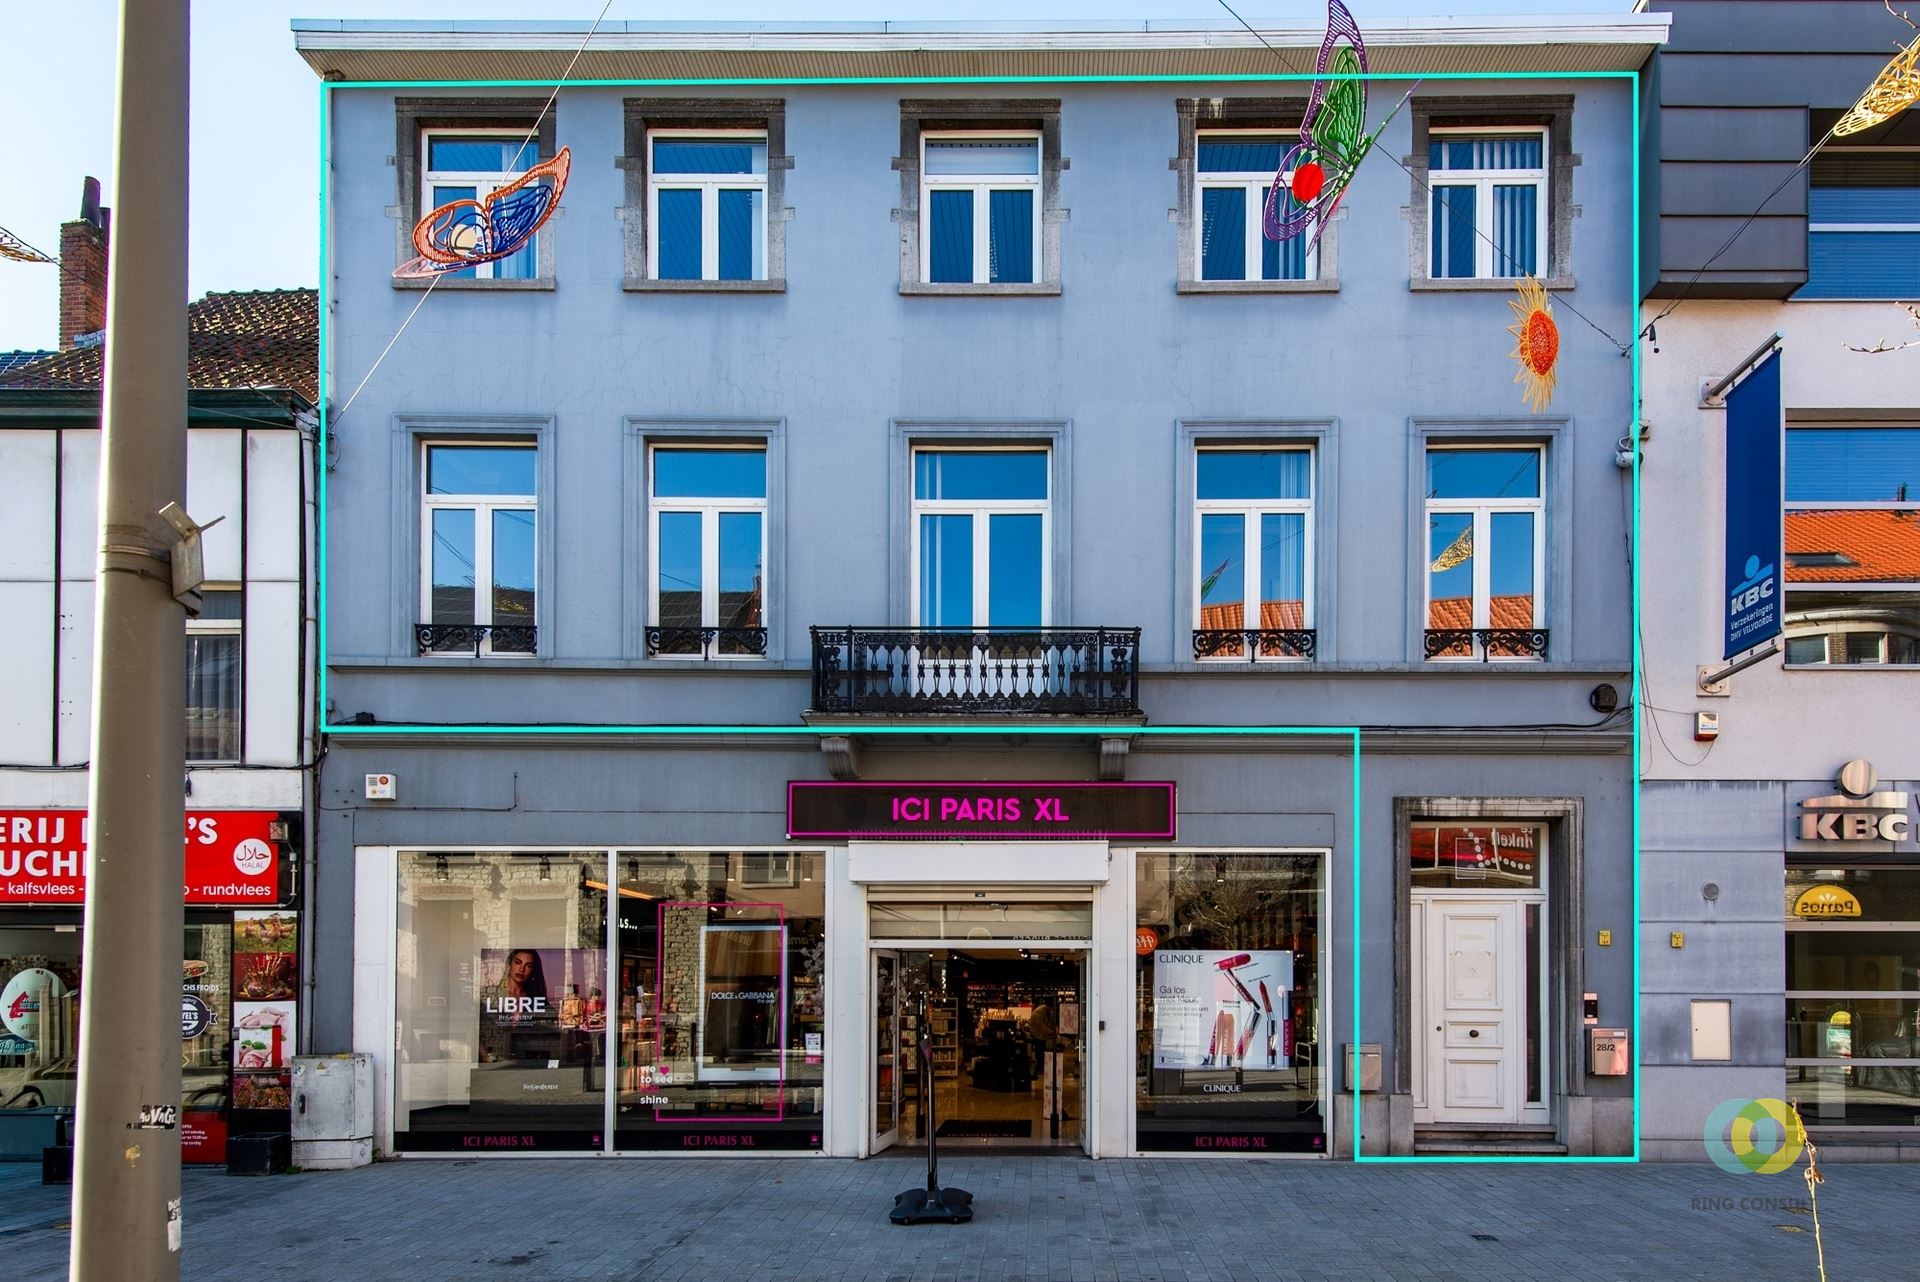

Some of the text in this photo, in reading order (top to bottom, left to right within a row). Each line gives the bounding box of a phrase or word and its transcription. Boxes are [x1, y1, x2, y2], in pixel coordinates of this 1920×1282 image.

[1731, 577, 1773, 616] KBC
[1730, 603, 1774, 630] Verzekeringen
[1743, 613, 1773, 635] VILVOORDE
[893, 798, 1069, 821] ICI PARIS XL
[1802, 813, 1908, 841] KBC
[8, 881, 75, 895] kalfsvlees
[203, 883, 271, 896] rundvlees
[1160, 954, 1204, 964] CLINIQUE
[1160, 985, 1173, 994] Ga
[486, 996, 546, 1013] LIBRE
[1596, 1043, 1616, 1052] 28/2
[640, 1075, 652, 1083] to
[1203, 1084, 1241, 1093] CLINIQUE
[640, 1095, 669, 1104] shine
[463, 1136, 536, 1147] ICI PARIS XL
[683, 1135, 755, 1146] ICI PARIS XL
[1195, 1136, 1268, 1148] ICI PARIS XL
